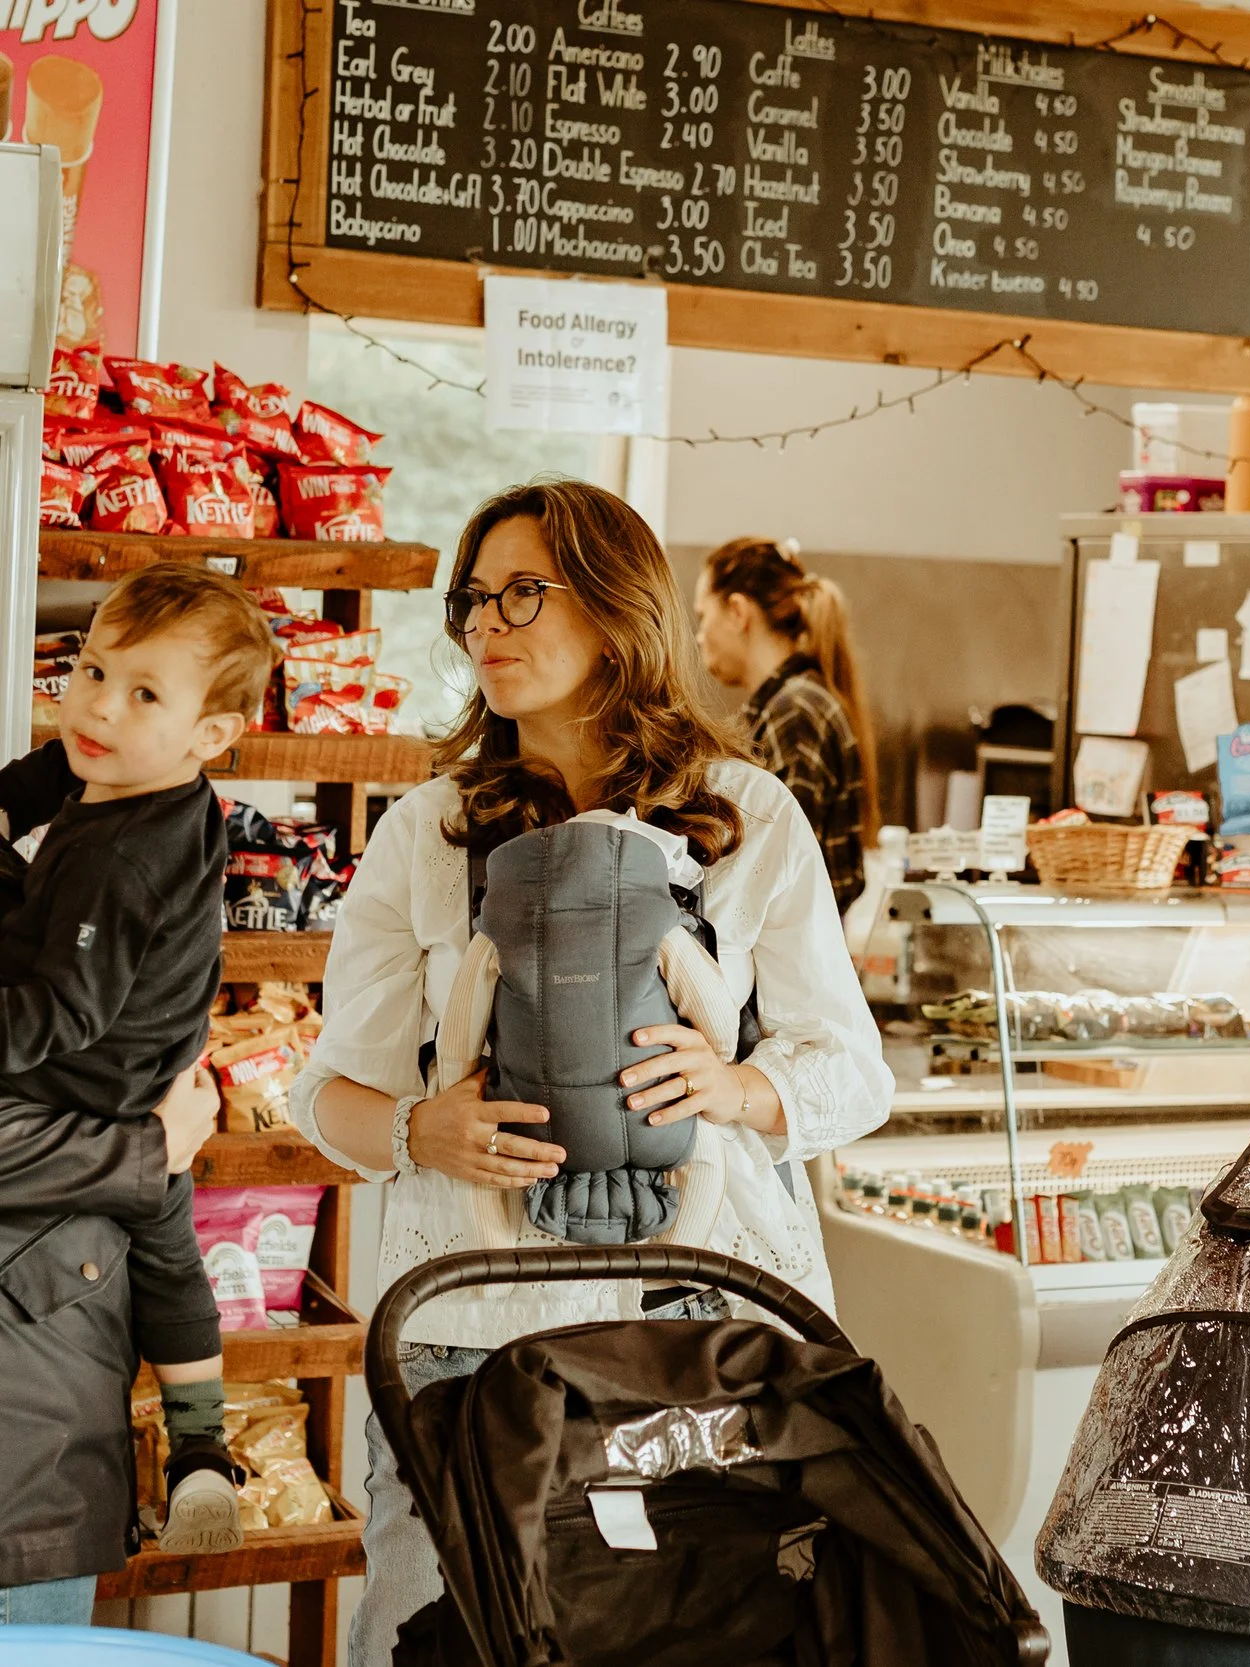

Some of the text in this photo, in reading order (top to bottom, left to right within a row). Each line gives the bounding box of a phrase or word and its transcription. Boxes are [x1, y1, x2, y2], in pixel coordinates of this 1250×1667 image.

[338, 0, 376, 37] Tea
[578, 0, 643, 32] Coffees
[785, 18, 835, 55] Lattes
[337, 39, 531, 97] Earl Grey 2.10
[548, 26, 722, 79] Americano 2.90
[749, 51, 801, 89] Caffe
[335, 79, 391, 120] Herbal
[394, 104, 415, 122] or
[483, 97, 533, 133] 2.10
[547, 65, 718, 117] Flat White 3.00
[747, 89, 818, 129] Caramel
[939, 74, 999, 115] Vanilla
[333, 120, 537, 169] Hot Chocolate 3.20
[545, 103, 713, 149] Espresso 2.40
[746, 127, 808, 165] Vanilla
[938, 111, 1013, 152] Chocolate
[331, 160, 362, 197] Hot
[488, 174, 540, 215] 3.70
[543, 141, 736, 196] Double Espresso 2.70
[743, 163, 820, 205] Hazelnut
[331, 199, 537, 253] Babyccino 1.00
[541, 181, 709, 230] Cappuccino 3.00
[742, 201, 895, 249] Iced 3.50
[934, 184, 1001, 224] Banana
[539, 219, 724, 276] Mochaccino 3.50
[740, 239, 891, 289] Chai Tea 3.50
[518, 309, 638, 340] Food Allergy
[517, 348, 637, 374] Intolerance?
